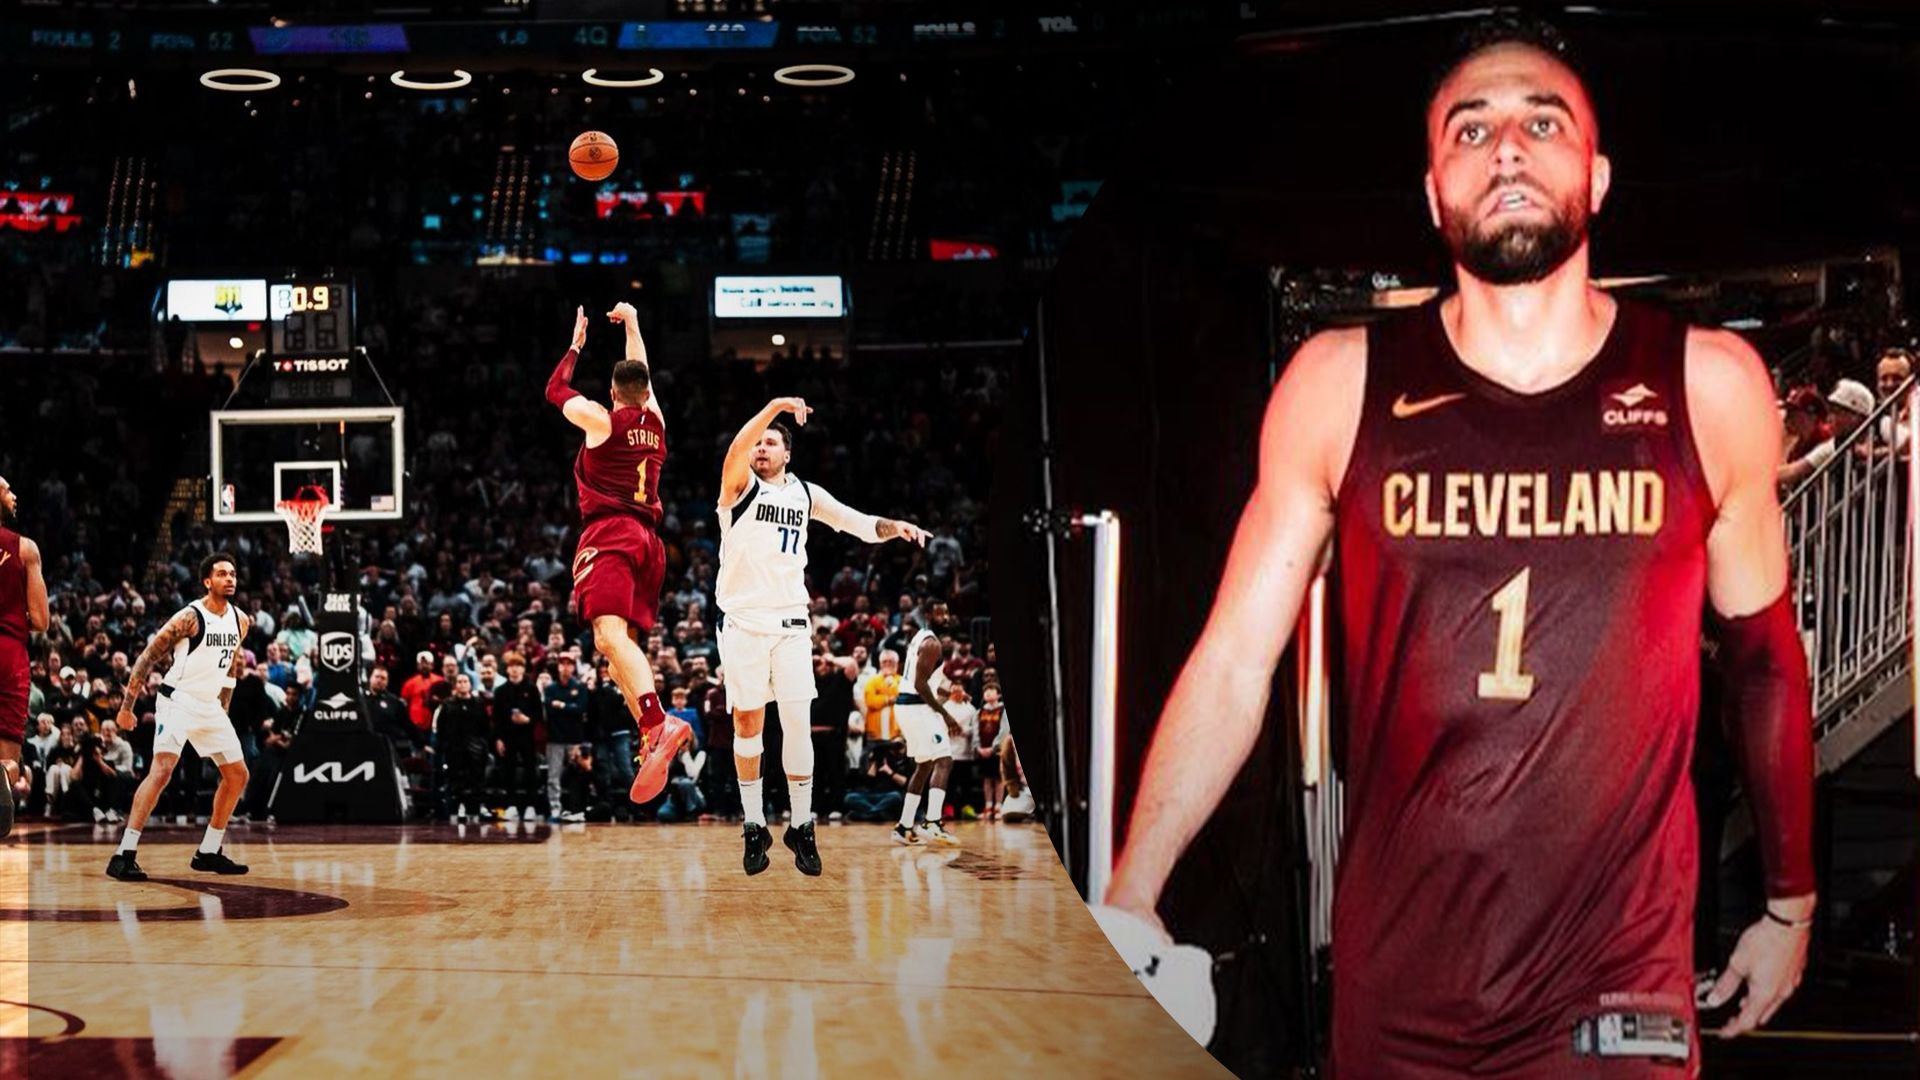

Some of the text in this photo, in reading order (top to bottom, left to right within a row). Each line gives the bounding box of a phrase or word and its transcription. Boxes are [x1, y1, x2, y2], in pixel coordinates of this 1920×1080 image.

[574, 25, 609, 47] 4Q
[293, 286, 330, 312] 0.9
[293, 358, 349, 372] TISSOT
[1603, 410, 1668, 425] CLIFFS
[627, 429, 660, 449] STRUS
[634, 457, 647, 503] 1
[756, 504, 803, 527] DALLAS
[1383, 471, 1664, 538] CLEVELAND
[778, 527, 800, 554] 77
[206, 633, 238, 647] DALLAS
[1477, 566, 1535, 701] 1
[324, 643, 352, 666] ups
[314, 711, 358, 721] CLIFFS
[294, 761, 375, 783] KIA
